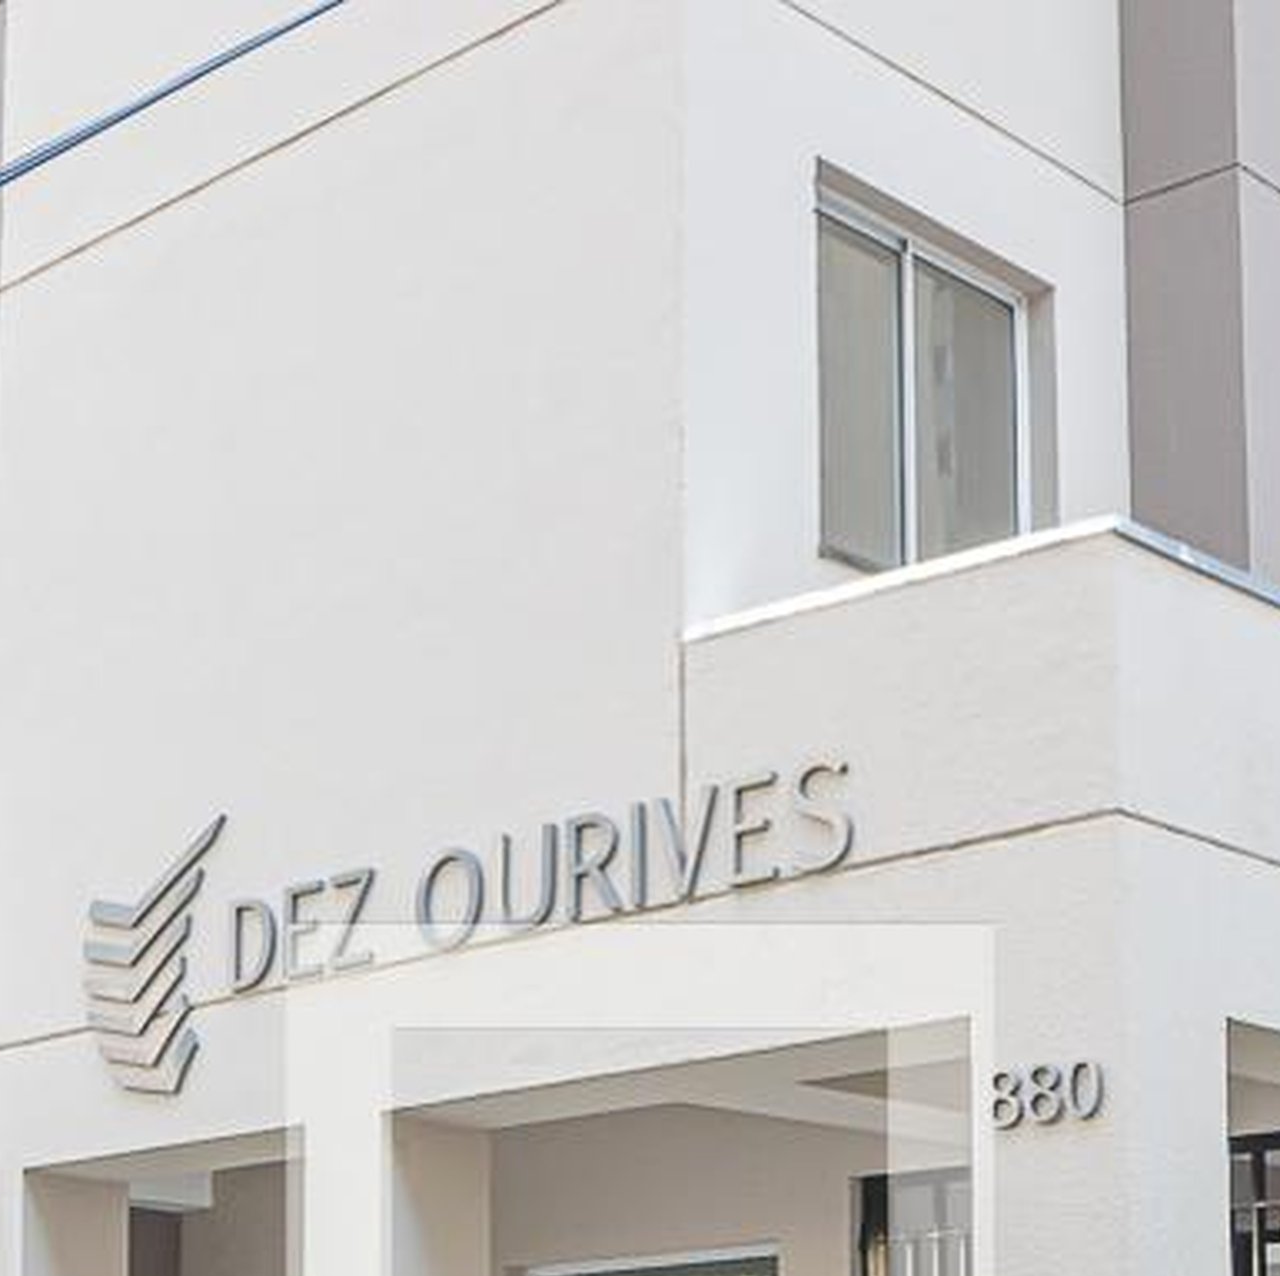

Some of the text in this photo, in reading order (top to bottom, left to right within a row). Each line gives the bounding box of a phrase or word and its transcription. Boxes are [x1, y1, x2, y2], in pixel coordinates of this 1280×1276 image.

[230, 761, 855, 995] DEZ OURIVES
[990, 1060, 1107, 1132] 880
